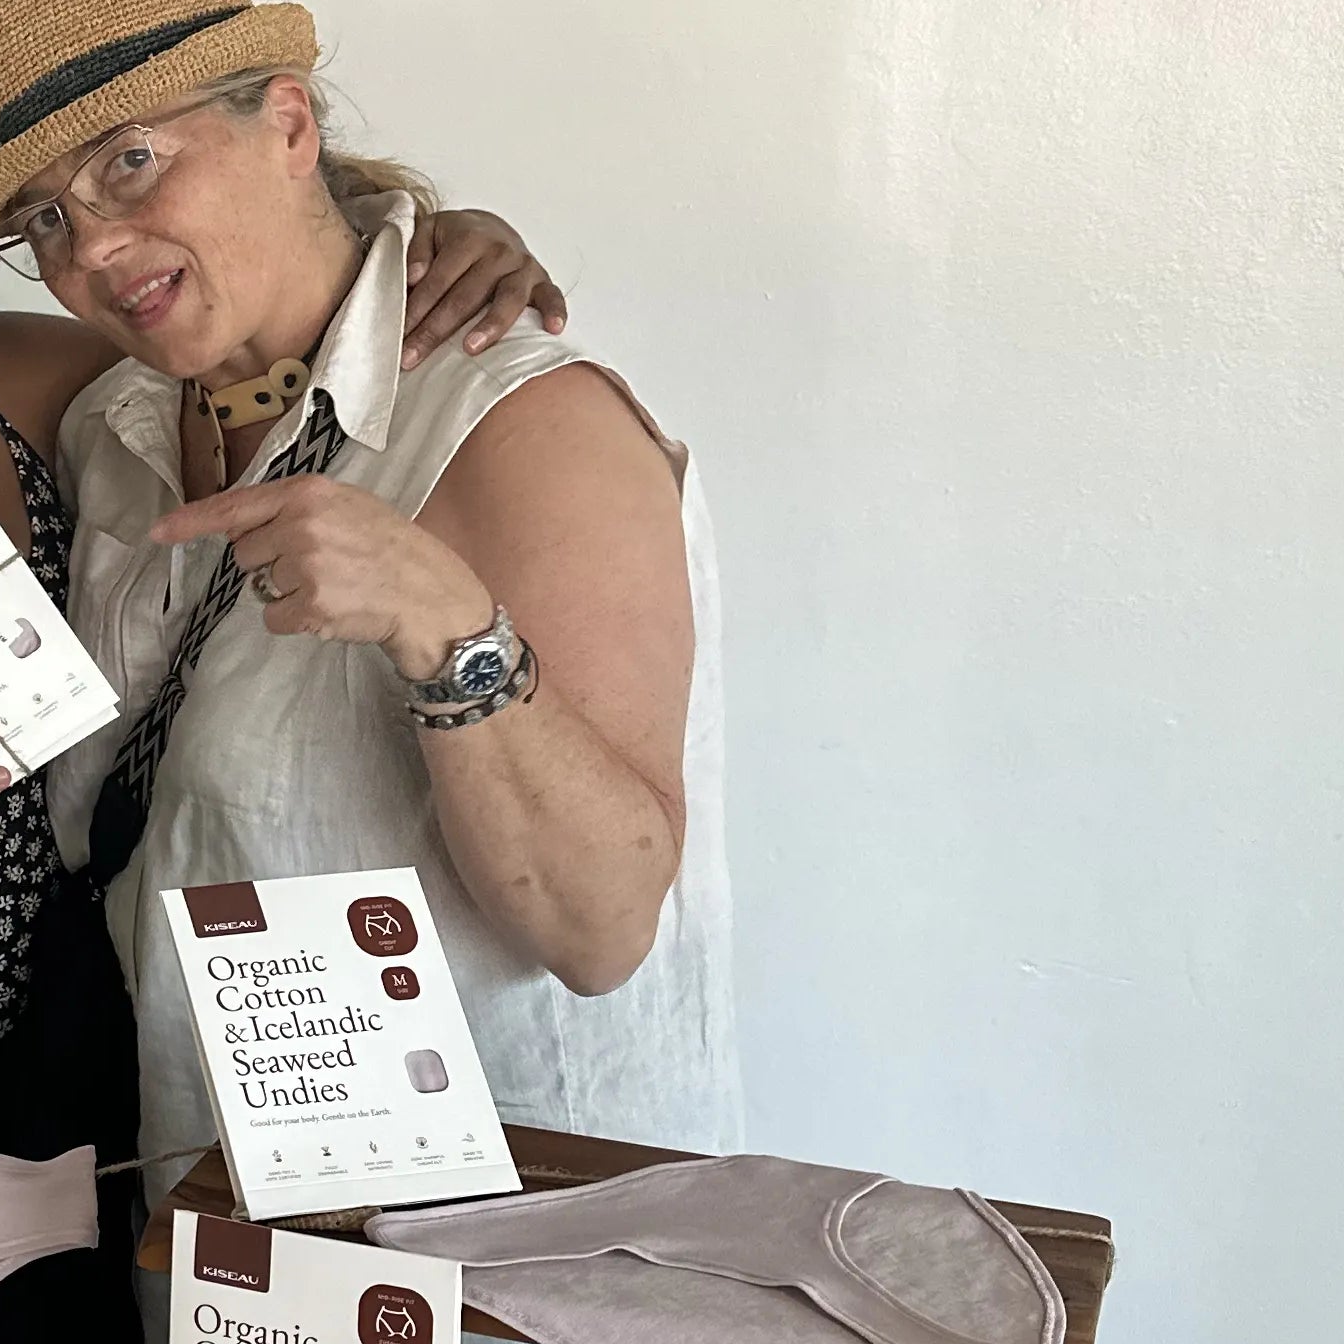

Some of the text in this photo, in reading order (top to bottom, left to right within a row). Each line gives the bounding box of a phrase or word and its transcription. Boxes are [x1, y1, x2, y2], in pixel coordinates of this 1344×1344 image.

[203, 920, 258, 932] KISEAU
[207, 949, 327, 988] Organic
[391, 973, 408, 987] M
[216, 986, 327, 1012] Cotton
[232, 1038, 357, 1077] Seaweed
[239, 1076, 349, 1109] Undies
[203, 1265, 259, 1285] KISEAU
